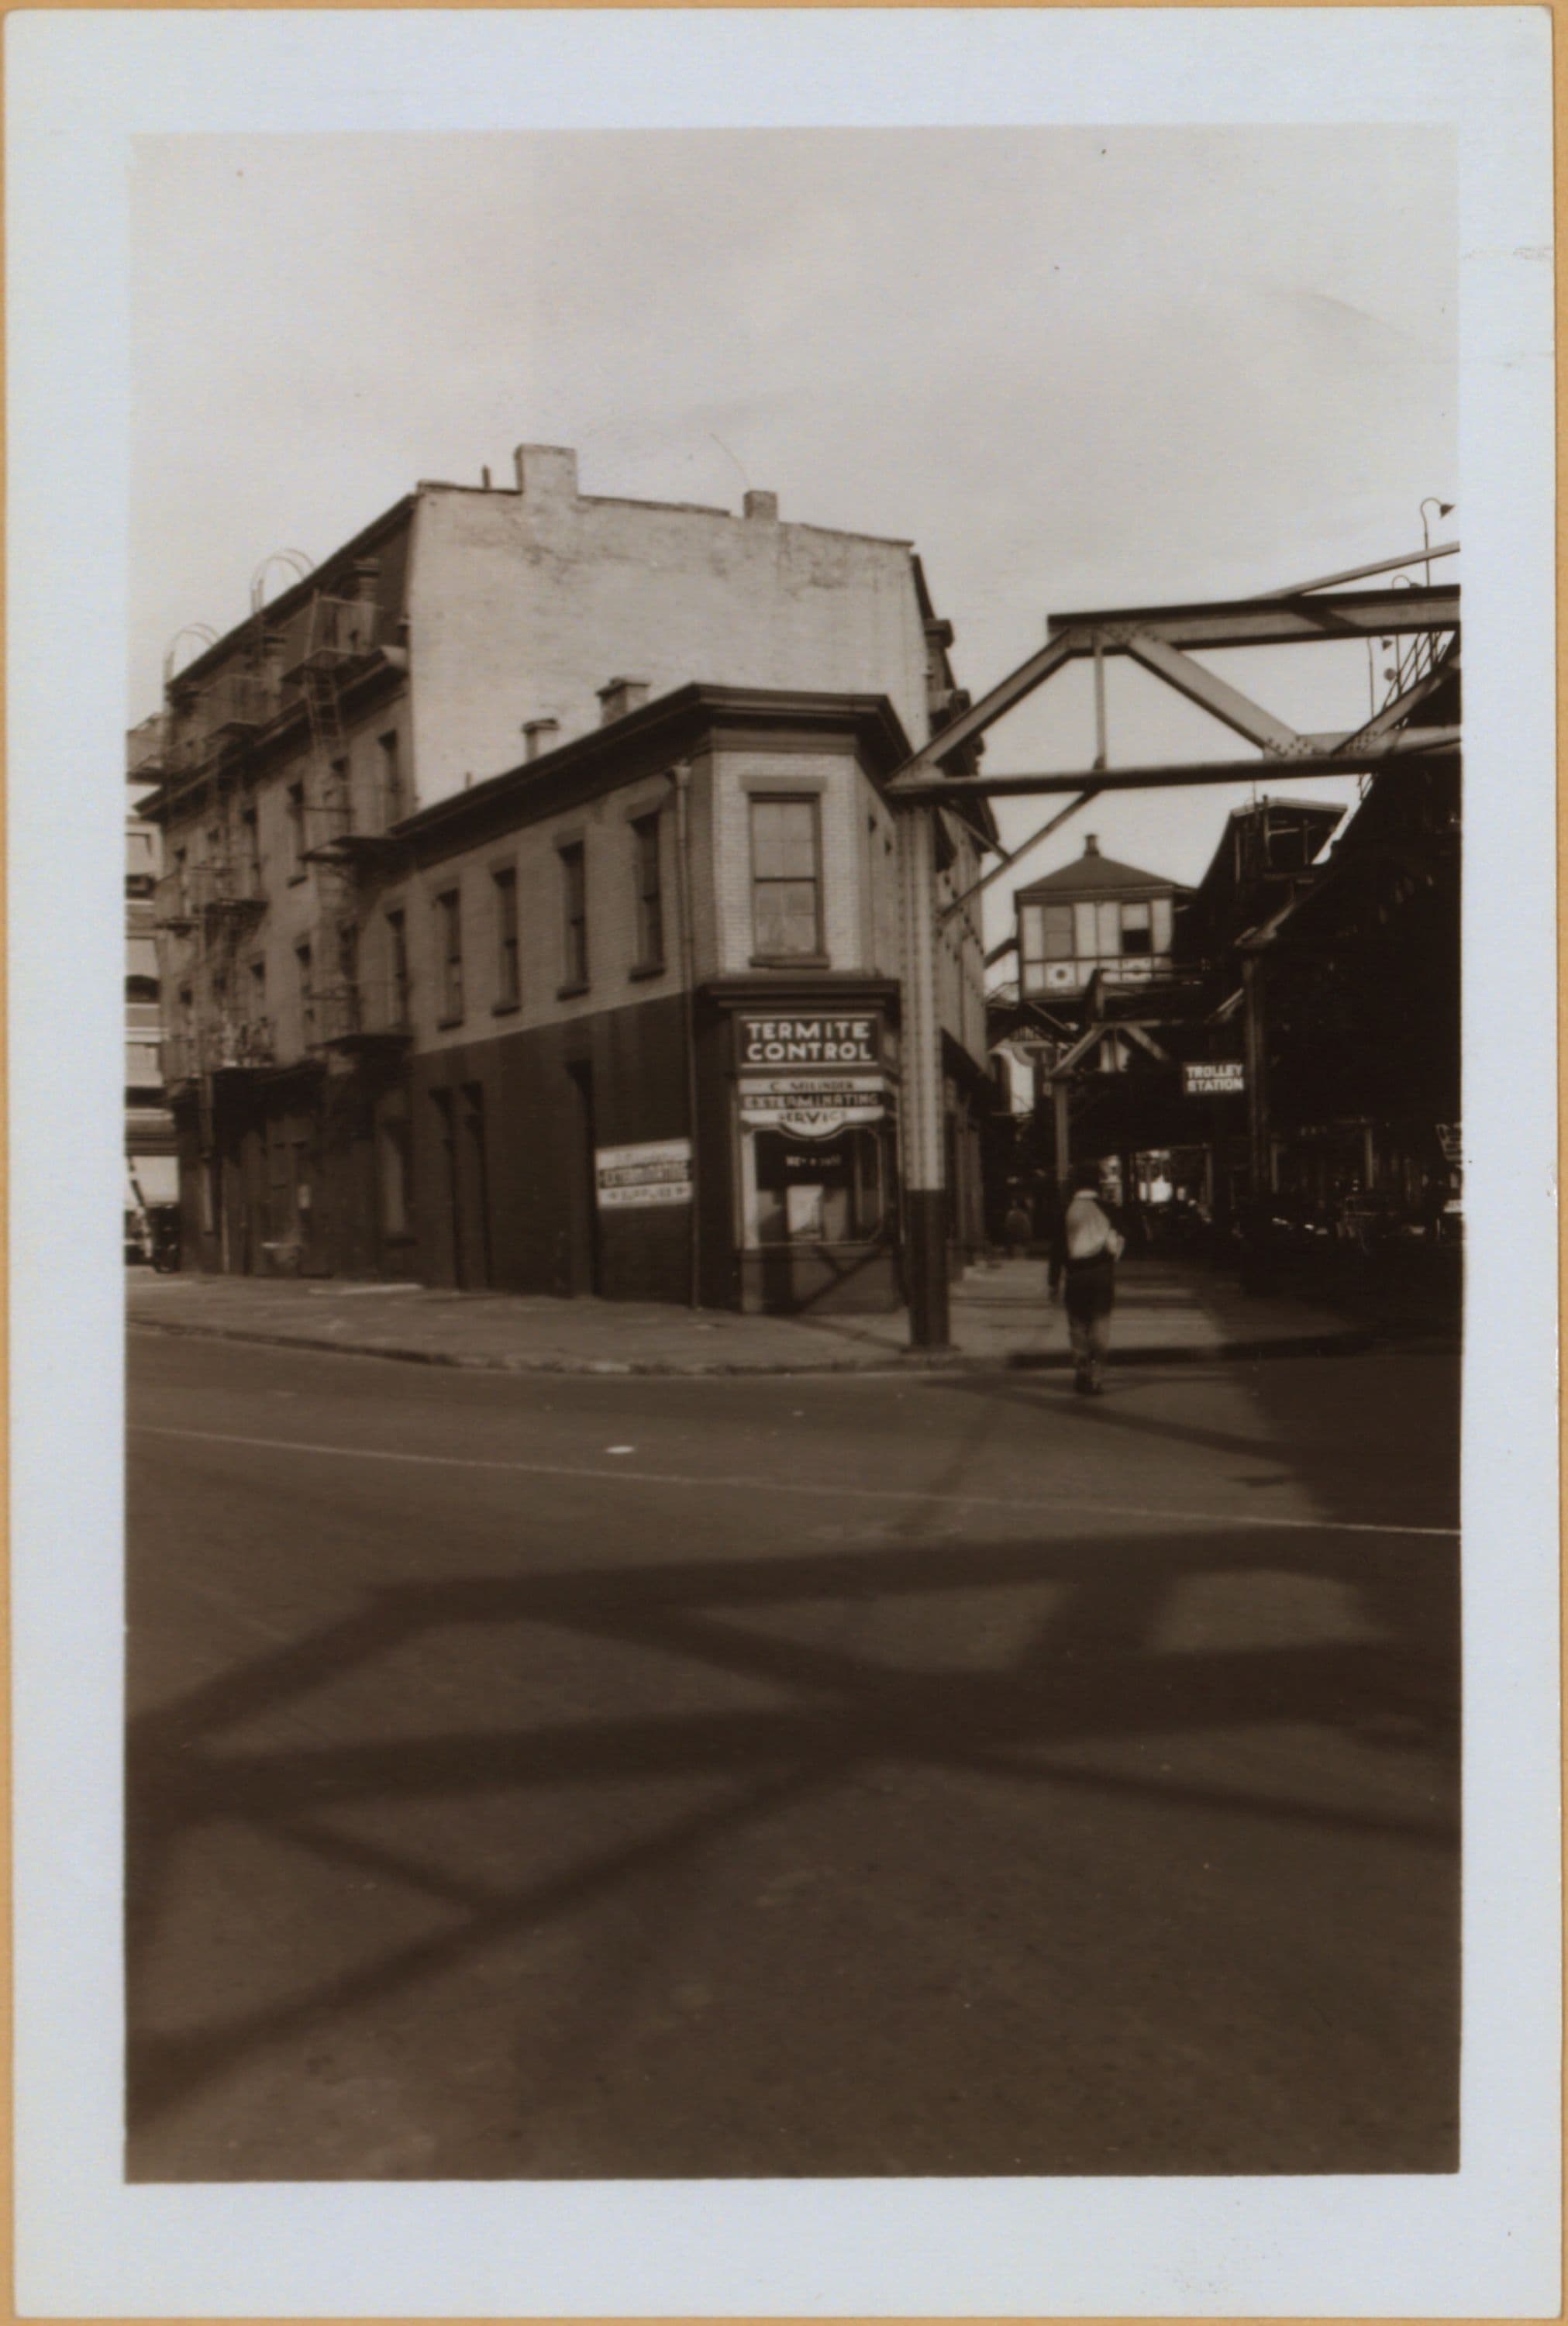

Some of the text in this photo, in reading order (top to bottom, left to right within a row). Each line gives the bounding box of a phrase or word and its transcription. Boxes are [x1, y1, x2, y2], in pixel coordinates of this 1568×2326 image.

[746, 1021, 870, 1040] TERMITE
[746, 1042, 873, 1061] CONTROL
[1186, 1063, 1243, 1078] TROLLEY
[1187, 1078, 1245, 1092] STATION
[743, 1093, 879, 1109] EXTERMINATING
